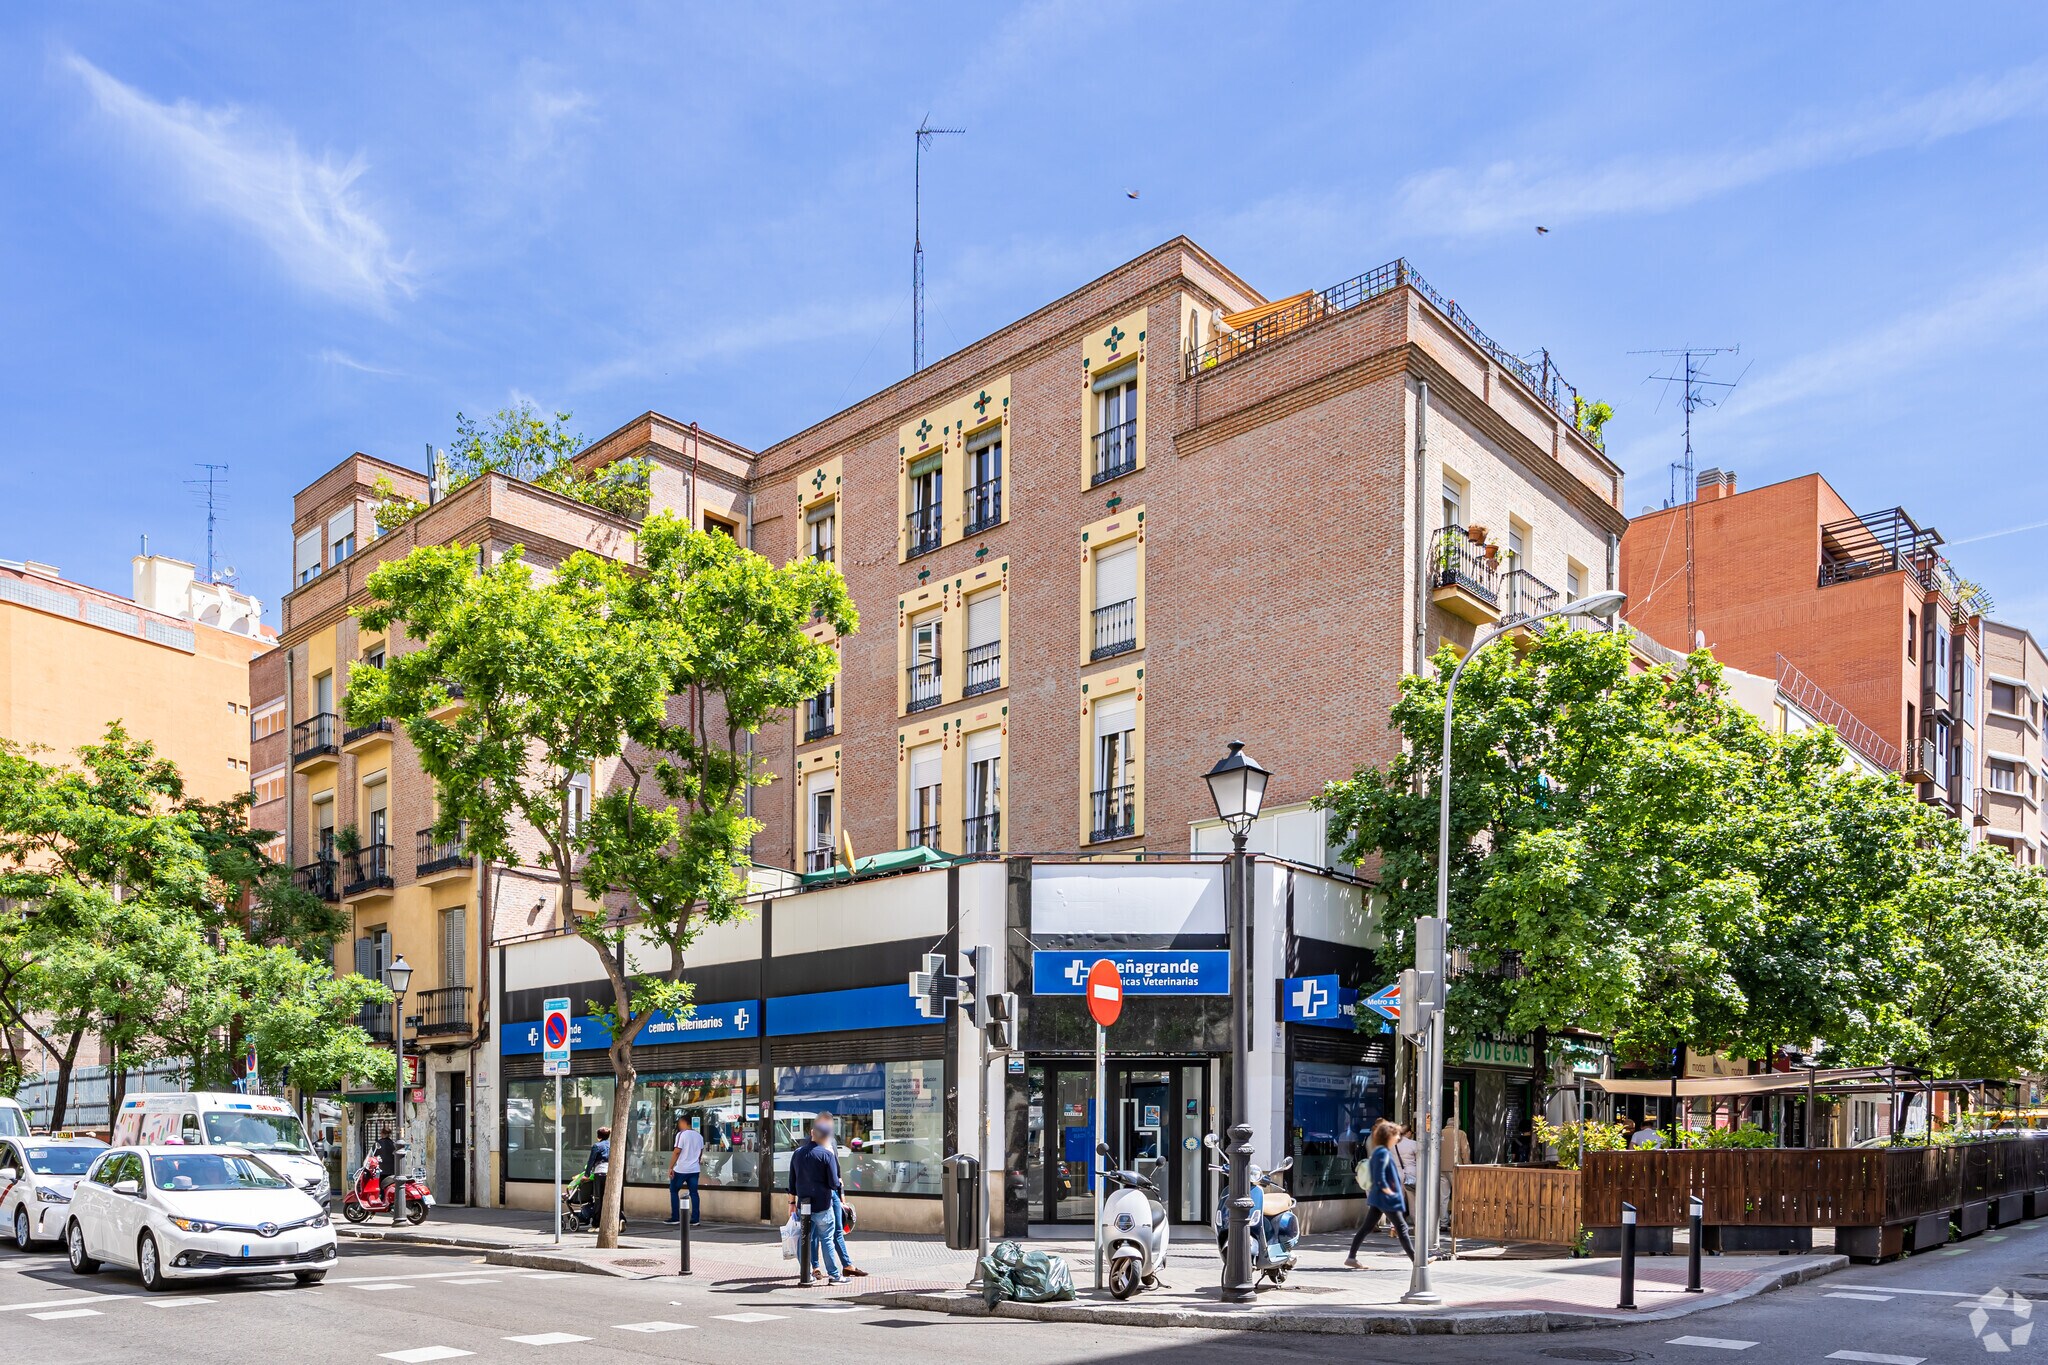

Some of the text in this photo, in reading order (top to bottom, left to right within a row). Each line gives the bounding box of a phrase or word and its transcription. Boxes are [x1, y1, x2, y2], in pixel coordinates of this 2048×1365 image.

[1109, 959, 1199, 977] eñagrande
[1120, 977, 1198, 986] nicas Veterinarias
[648, 1016, 723, 1034] centros veterinarios
[1493, 1030, 1517, 1042] BAR
[1583, 1040, 1613, 1053] TAPAS
[1468, 1040, 1528, 1063] ODEGAS
[257, 1104, 283, 1113] SEUR
